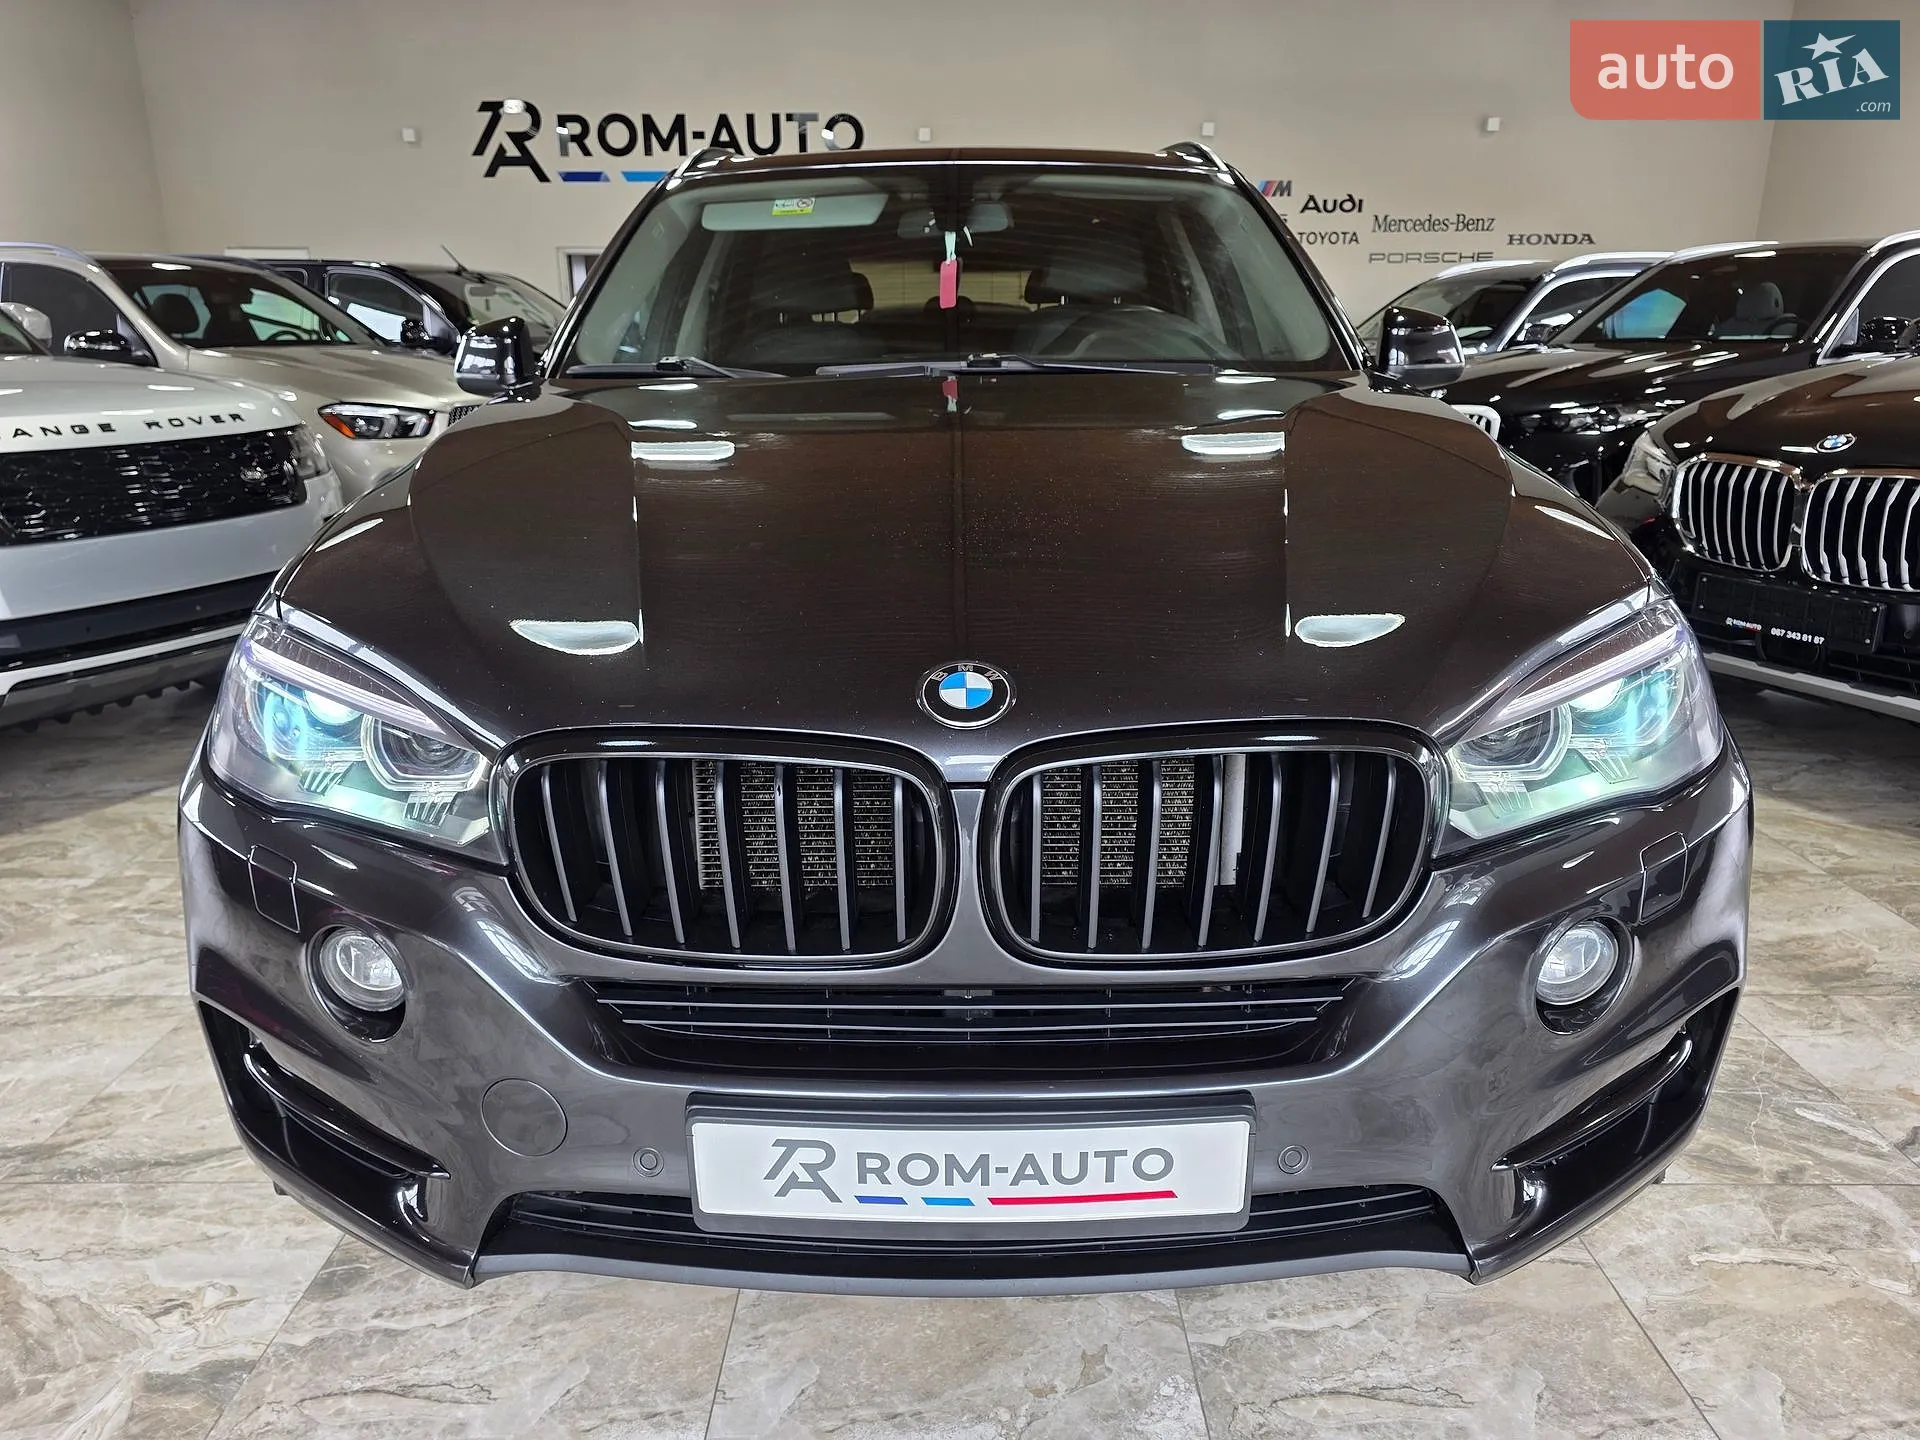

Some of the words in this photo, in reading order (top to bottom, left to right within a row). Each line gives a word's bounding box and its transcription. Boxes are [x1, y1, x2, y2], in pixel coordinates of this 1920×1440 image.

[556, 113, 864, 156] ROM-AUTO
[1300, 194, 1363, 213] Audi
[1372, 214, 1496, 233] Mercedes-Benz
[1297, 231, 1360, 245] TOYOTA
[1507, 233, 1596, 246] HONDA
[1368, 252, 1495, 264] PORSCHE
[0, 423, 117, 439] ANGE
[143, 413, 246, 430] ROVER
[930, 664, 1004, 681] BMW
[856, 1147, 1175, 1187] ROM-AUTO
